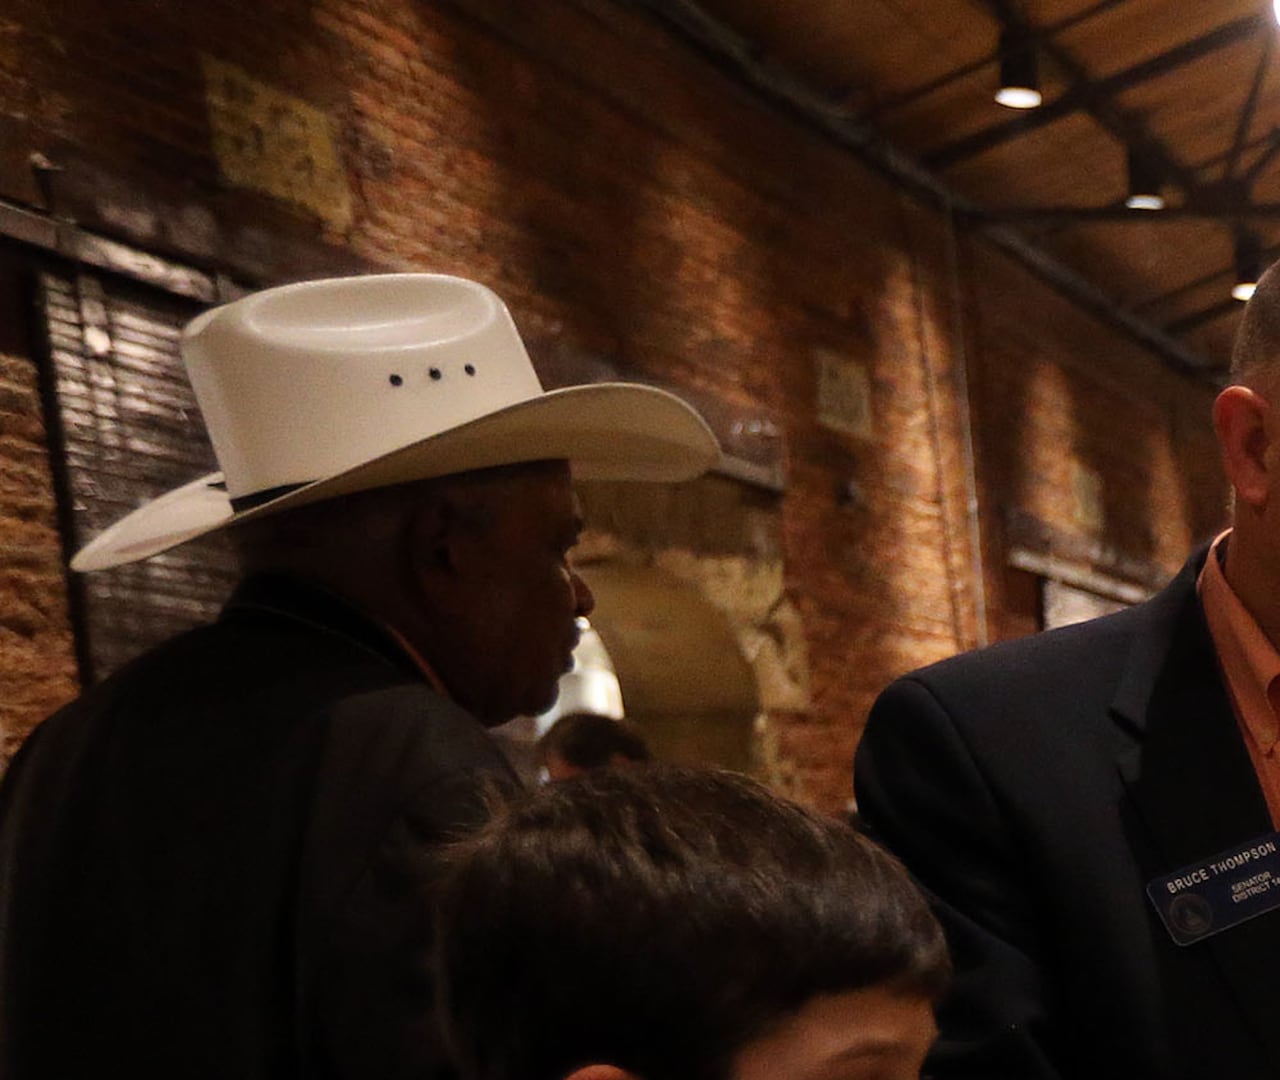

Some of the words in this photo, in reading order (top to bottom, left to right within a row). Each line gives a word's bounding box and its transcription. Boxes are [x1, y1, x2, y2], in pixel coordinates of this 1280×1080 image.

[1167, 869, 1209, 893] BRUCE
[1211, 842, 1276, 875] THOMPSON
[1232, 872, 1271, 892] SENATOR
[1232, 883, 1271, 903] DISTRICT
